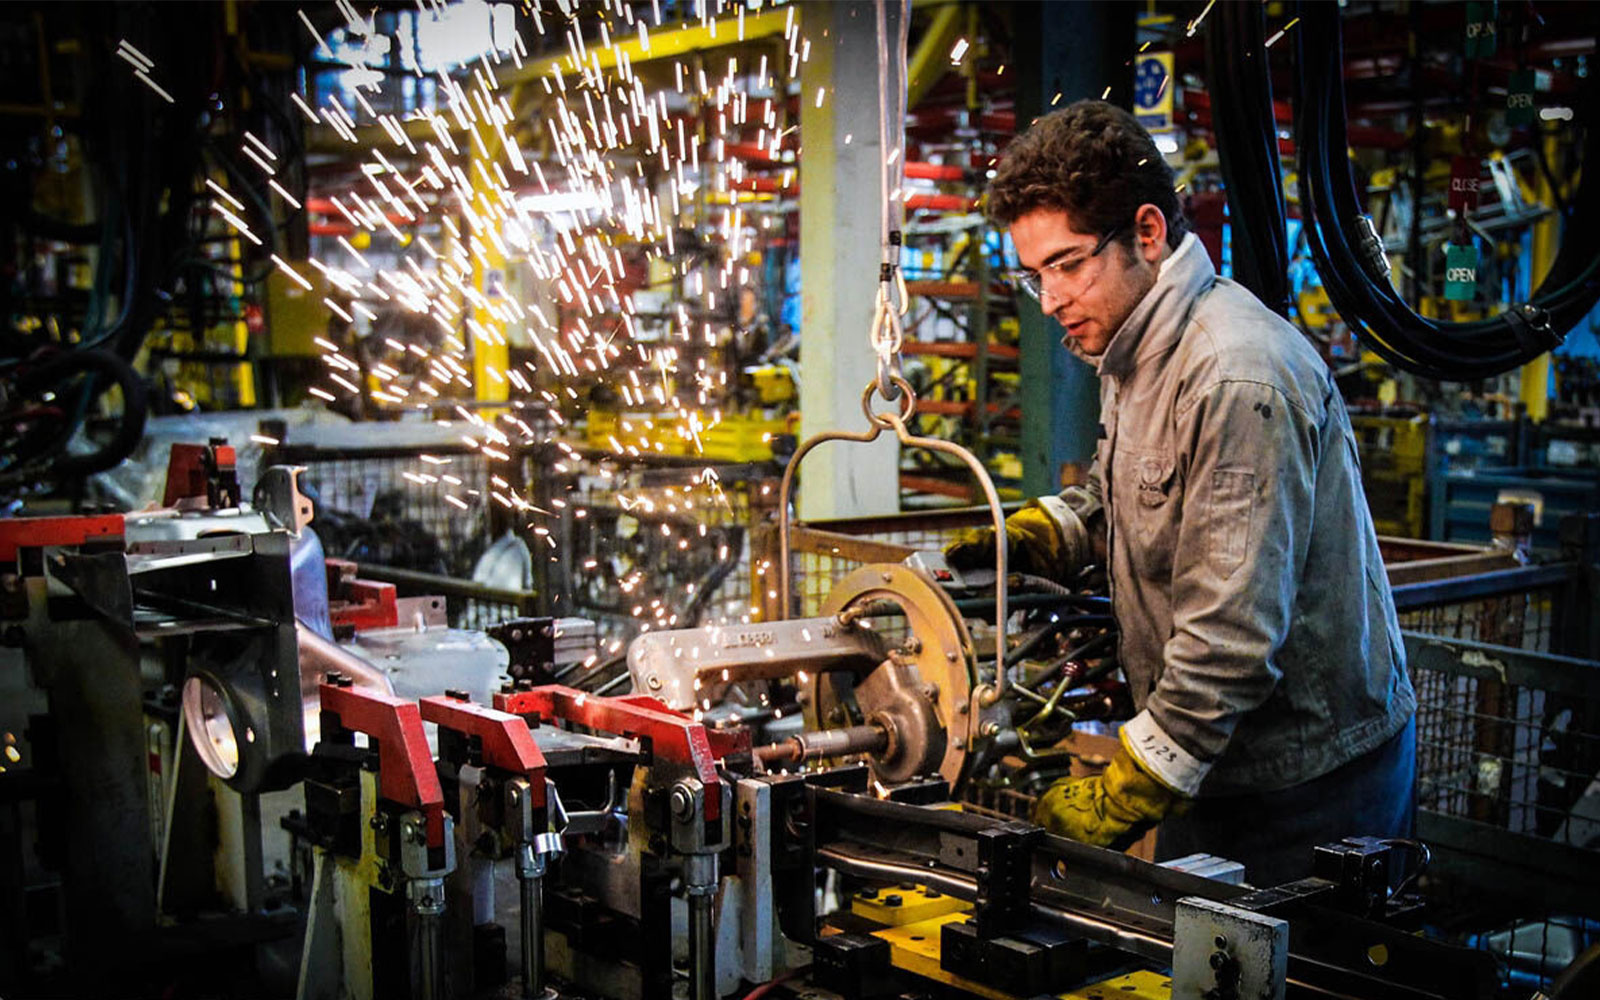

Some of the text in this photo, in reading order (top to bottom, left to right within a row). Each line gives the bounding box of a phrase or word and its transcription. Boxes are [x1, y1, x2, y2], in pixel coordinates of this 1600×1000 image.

[1507, 93, 1533, 108] OPEN
[1451, 177, 1480, 192] CLOSE
[1447, 267, 1475, 282] OPEN
